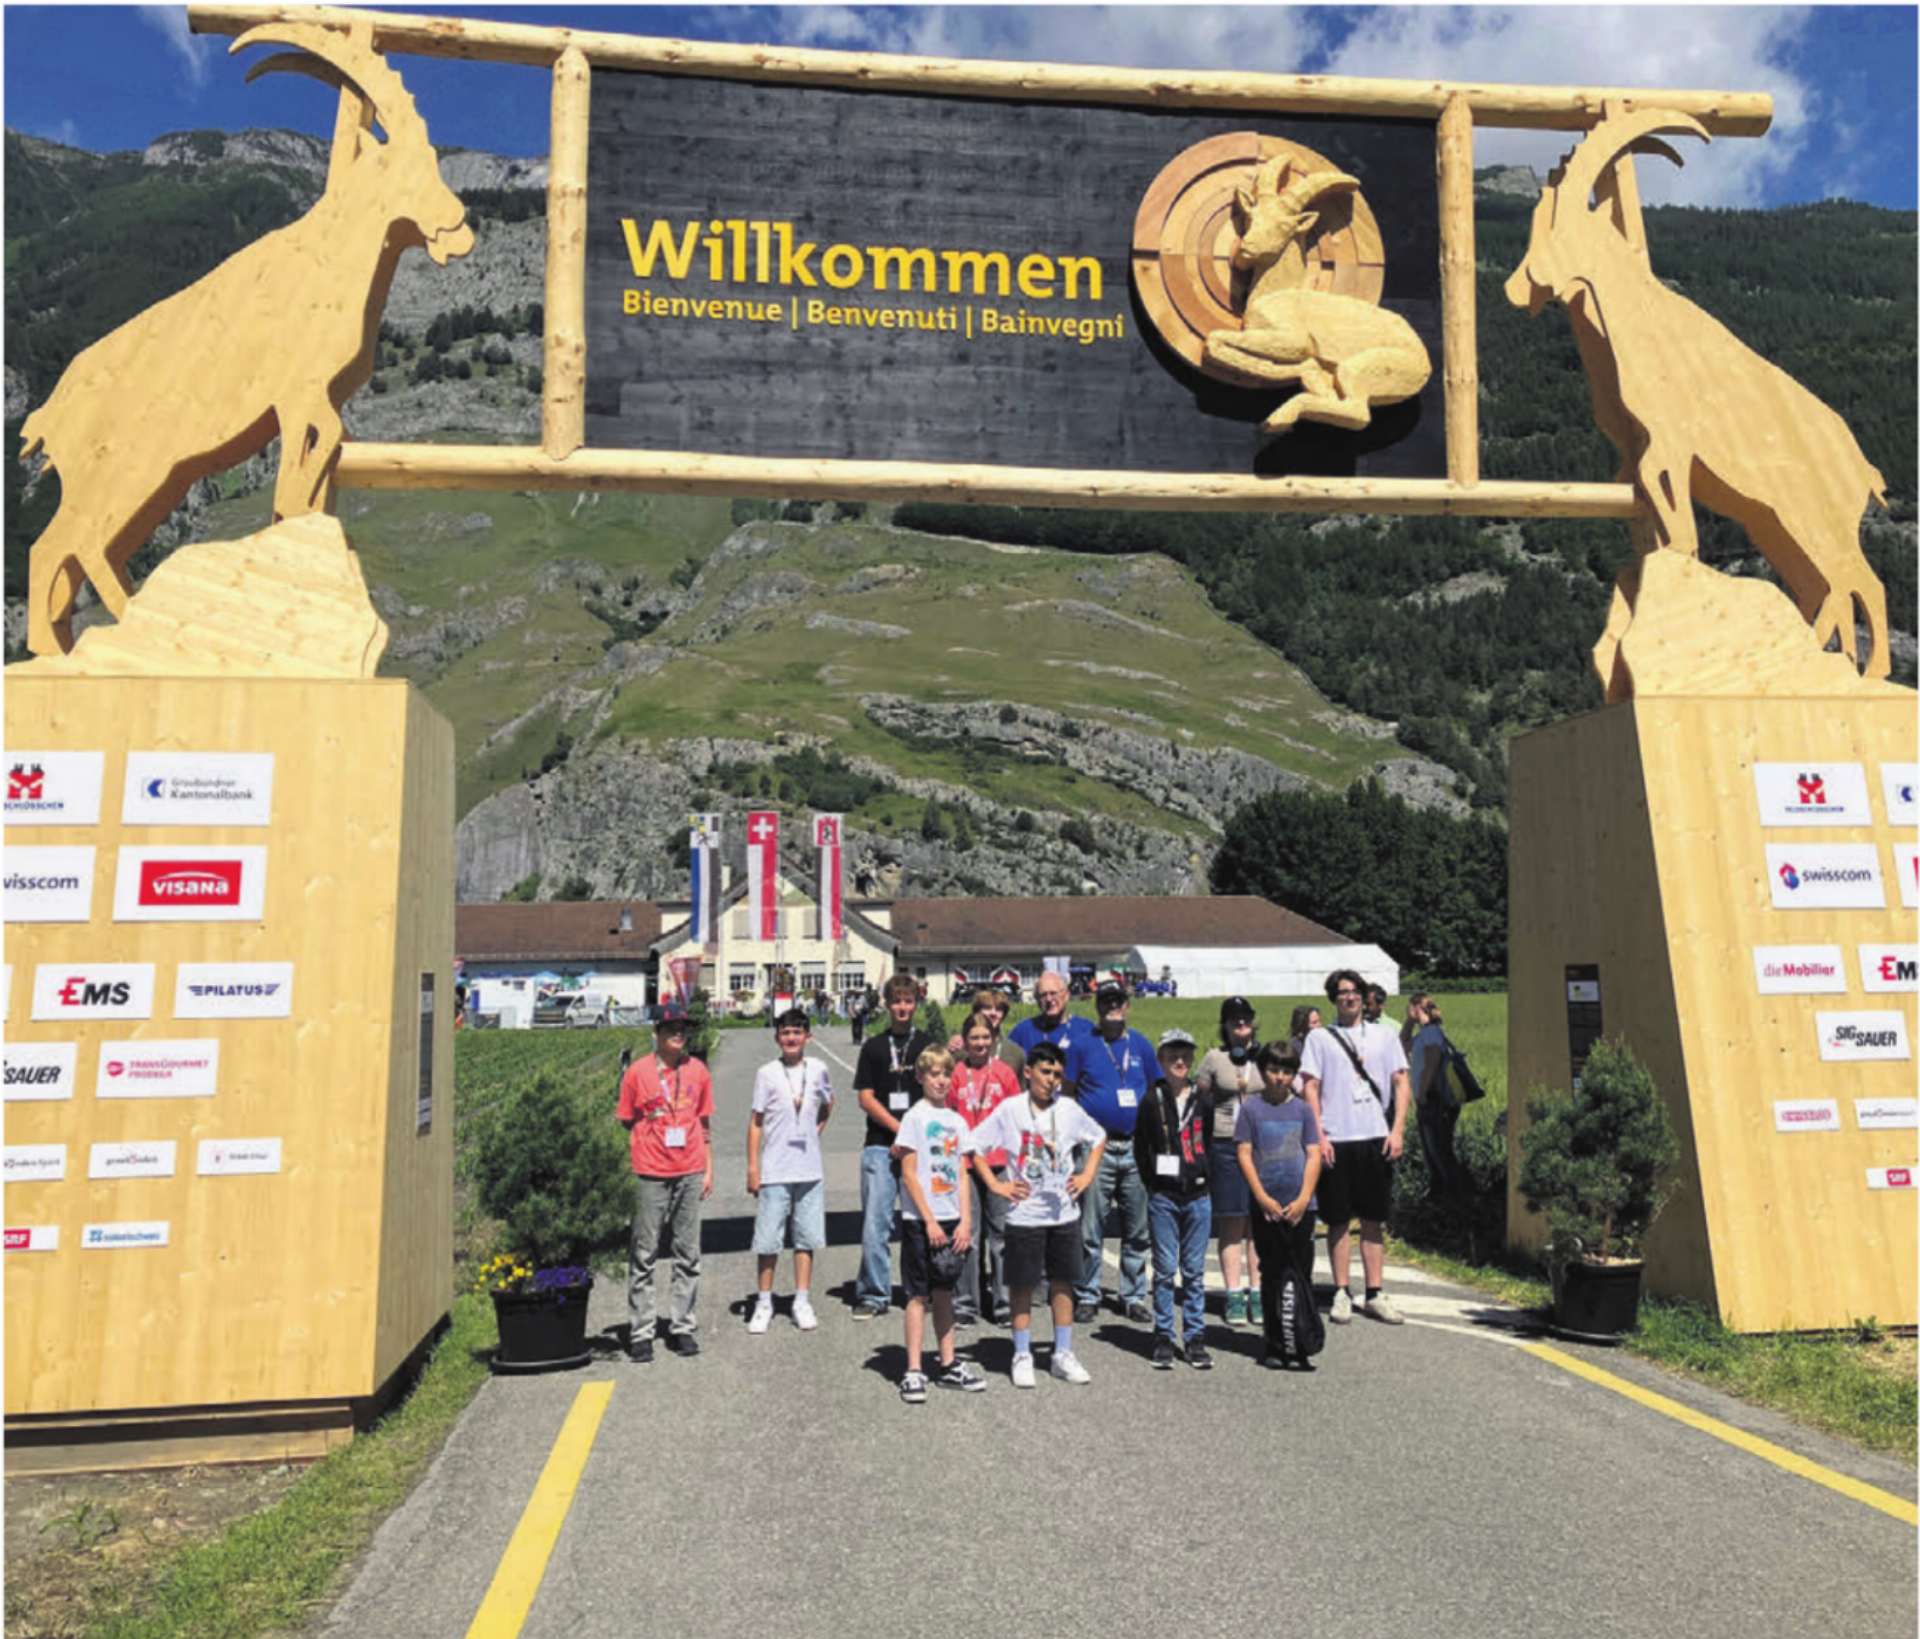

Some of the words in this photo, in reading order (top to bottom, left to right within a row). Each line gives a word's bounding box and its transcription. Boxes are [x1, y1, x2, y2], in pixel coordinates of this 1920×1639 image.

[622, 219, 1103, 300] Willkommen
[623, 289, 782, 321] Bienvenue
[807, 300, 957, 330] Benvenuti
[981, 308, 1124, 345] Bainvegni
[170, 789, 253, 799] Kantonalbank
[1801, 866, 1872, 882] swisscom
[1782, 963, 1836, 977] Mobiliar
[1877, 955, 1918, 981] EM
[58, 977, 131, 1006] EMS
[204, 984, 264, 997] PILATUS
[1835, 1025, 1857, 1040] SIG
[1856, 1031, 1898, 1047] SAUER
[4, 1066, 62, 1085] SAUER
